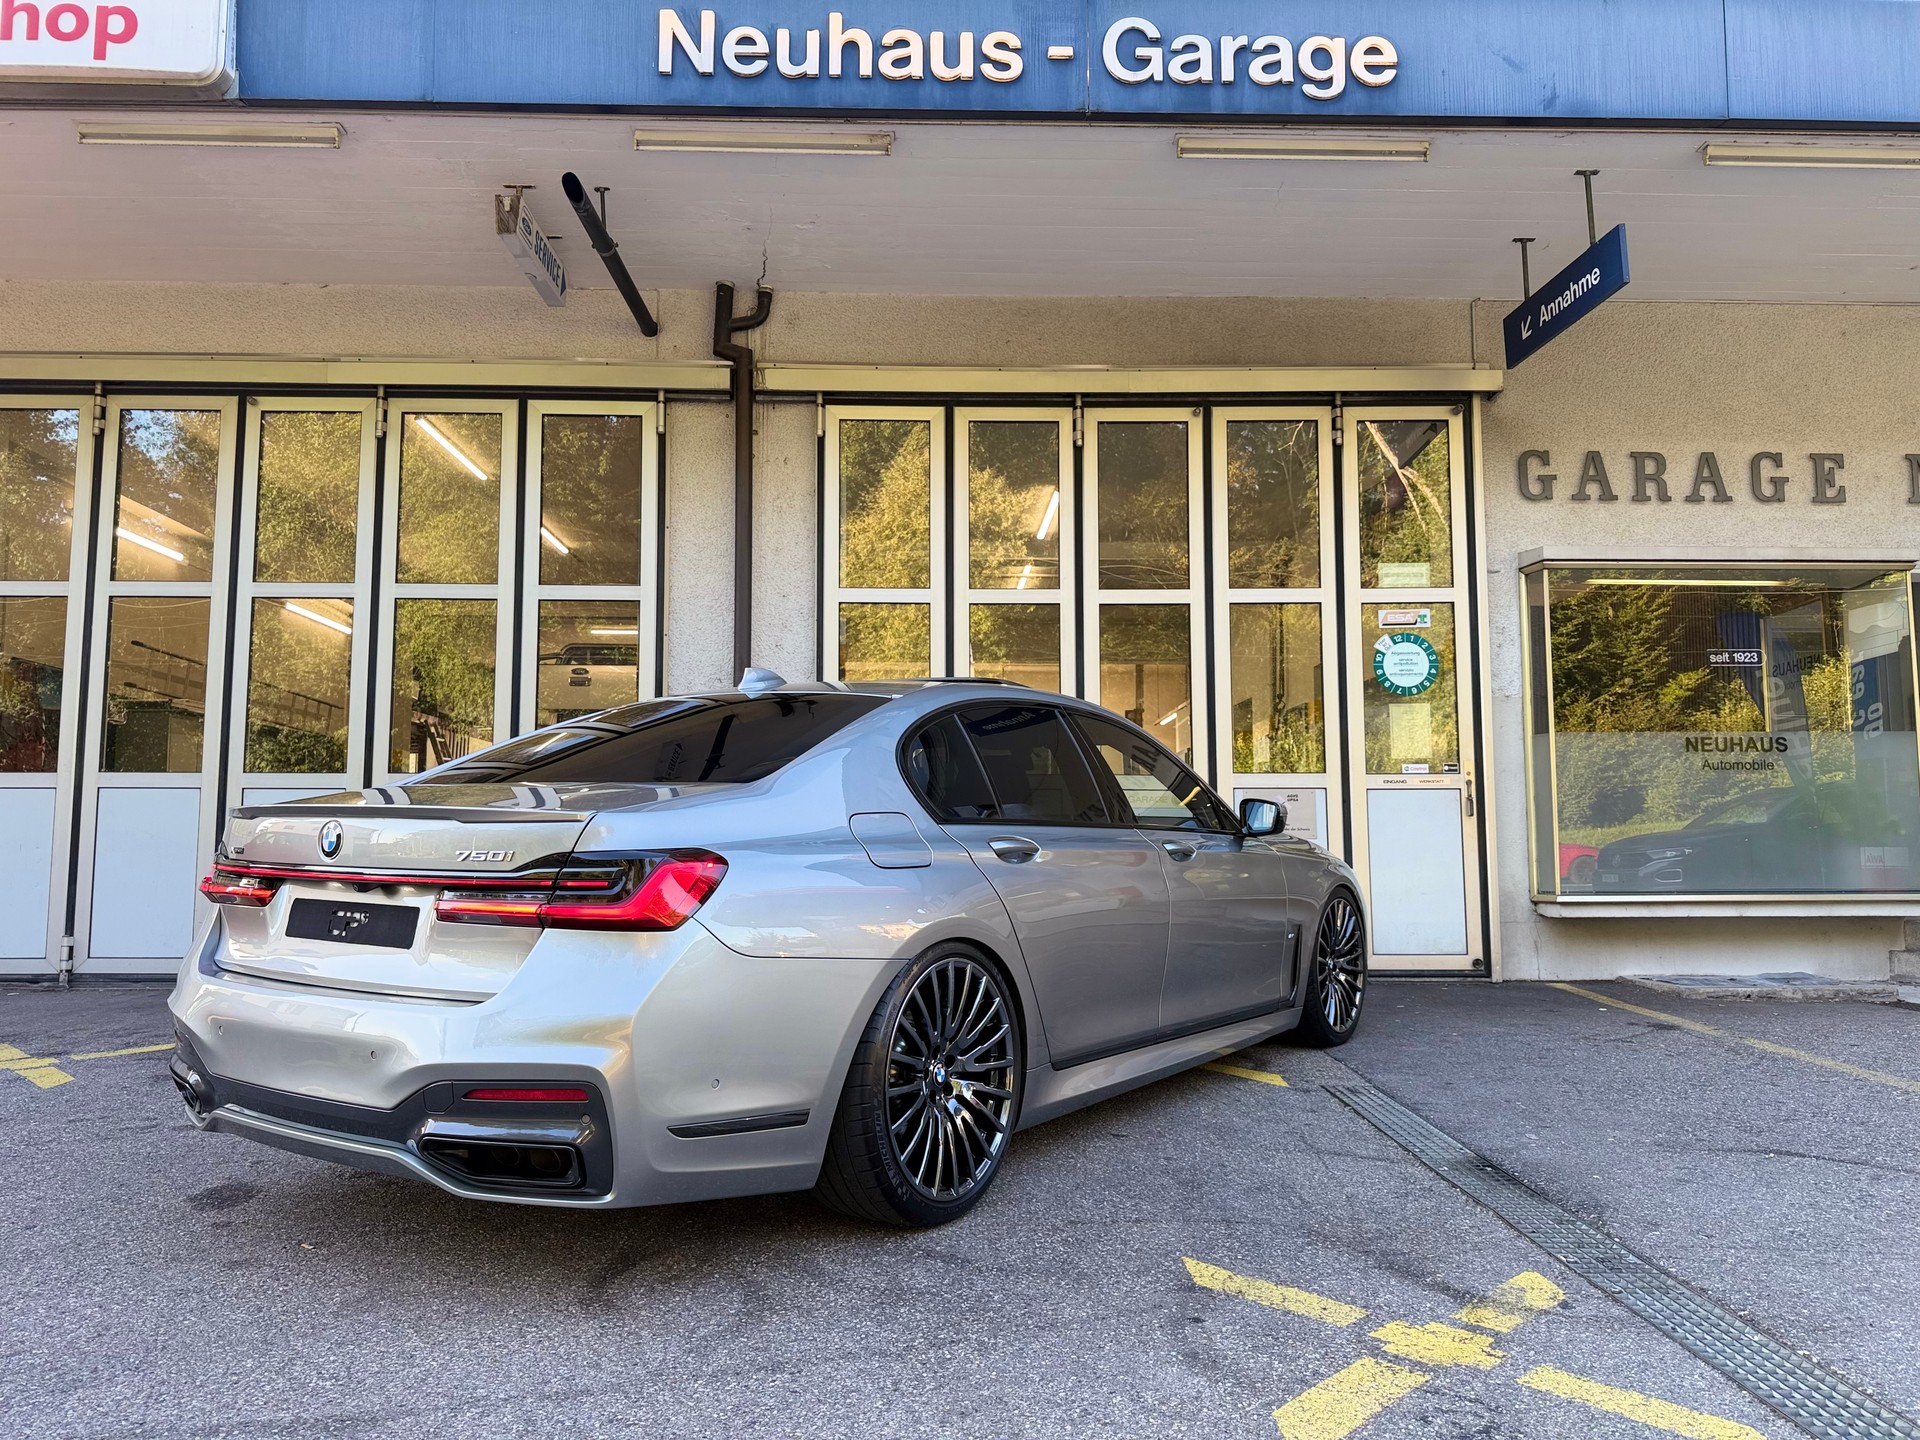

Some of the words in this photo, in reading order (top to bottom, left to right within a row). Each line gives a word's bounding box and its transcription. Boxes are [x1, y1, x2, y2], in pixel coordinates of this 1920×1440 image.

[0, 0, 138, 60] hop
[658, 8, 1024, 83] Neuhaus
[1103, 17, 1398, 100] Garage
[534, 229, 561, 288] SERVICE
[1539, 267, 1601, 327] Annahme
[1517, 449, 1847, 503] GARAGE
[1393, 635, 1404, 643] 12
[1421, 642, 1429, 650] 2
[1375, 653, 1383, 662] 10
[1709, 652, 1730, 663] seit
[1733, 652, 1758, 662] 1923
[1383, 680, 1391, 688] 8
[1396, 687, 1402, 695] 7
[1685, 736, 1789, 753] NEUHAUS
[1702, 759, 1775, 771] Automobile
[455, 850, 515, 862] 750i
